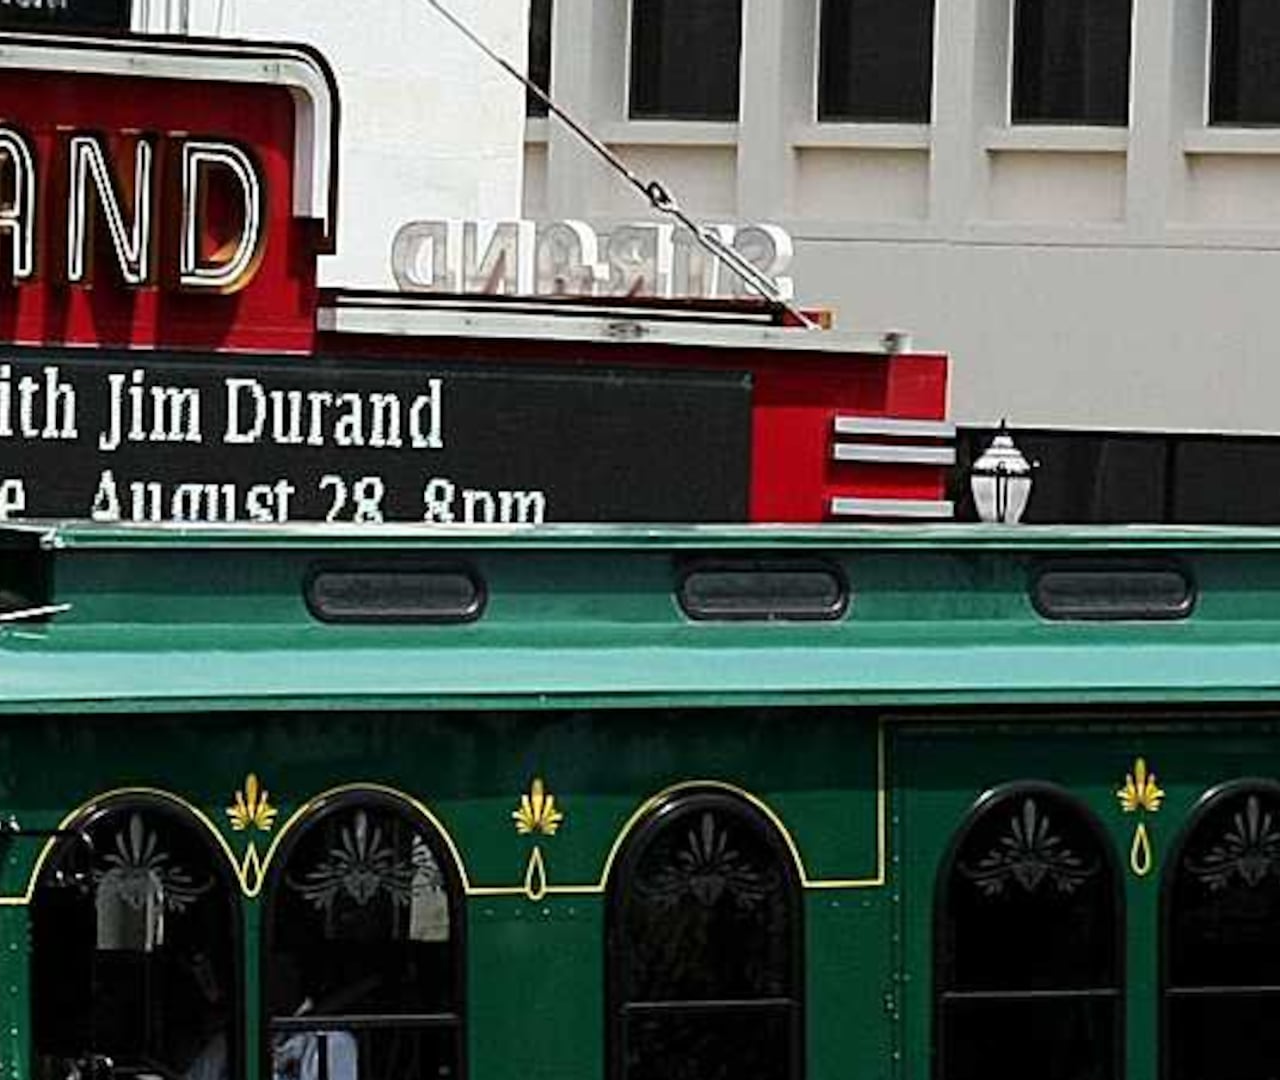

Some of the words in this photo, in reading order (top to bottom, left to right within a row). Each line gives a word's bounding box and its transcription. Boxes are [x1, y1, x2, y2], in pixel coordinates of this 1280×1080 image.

[98, 369, 203, 451] Jim
[222, 377, 444, 449] Durand
[91, 469, 295, 523] August
[320, 474, 385, 524] 28
